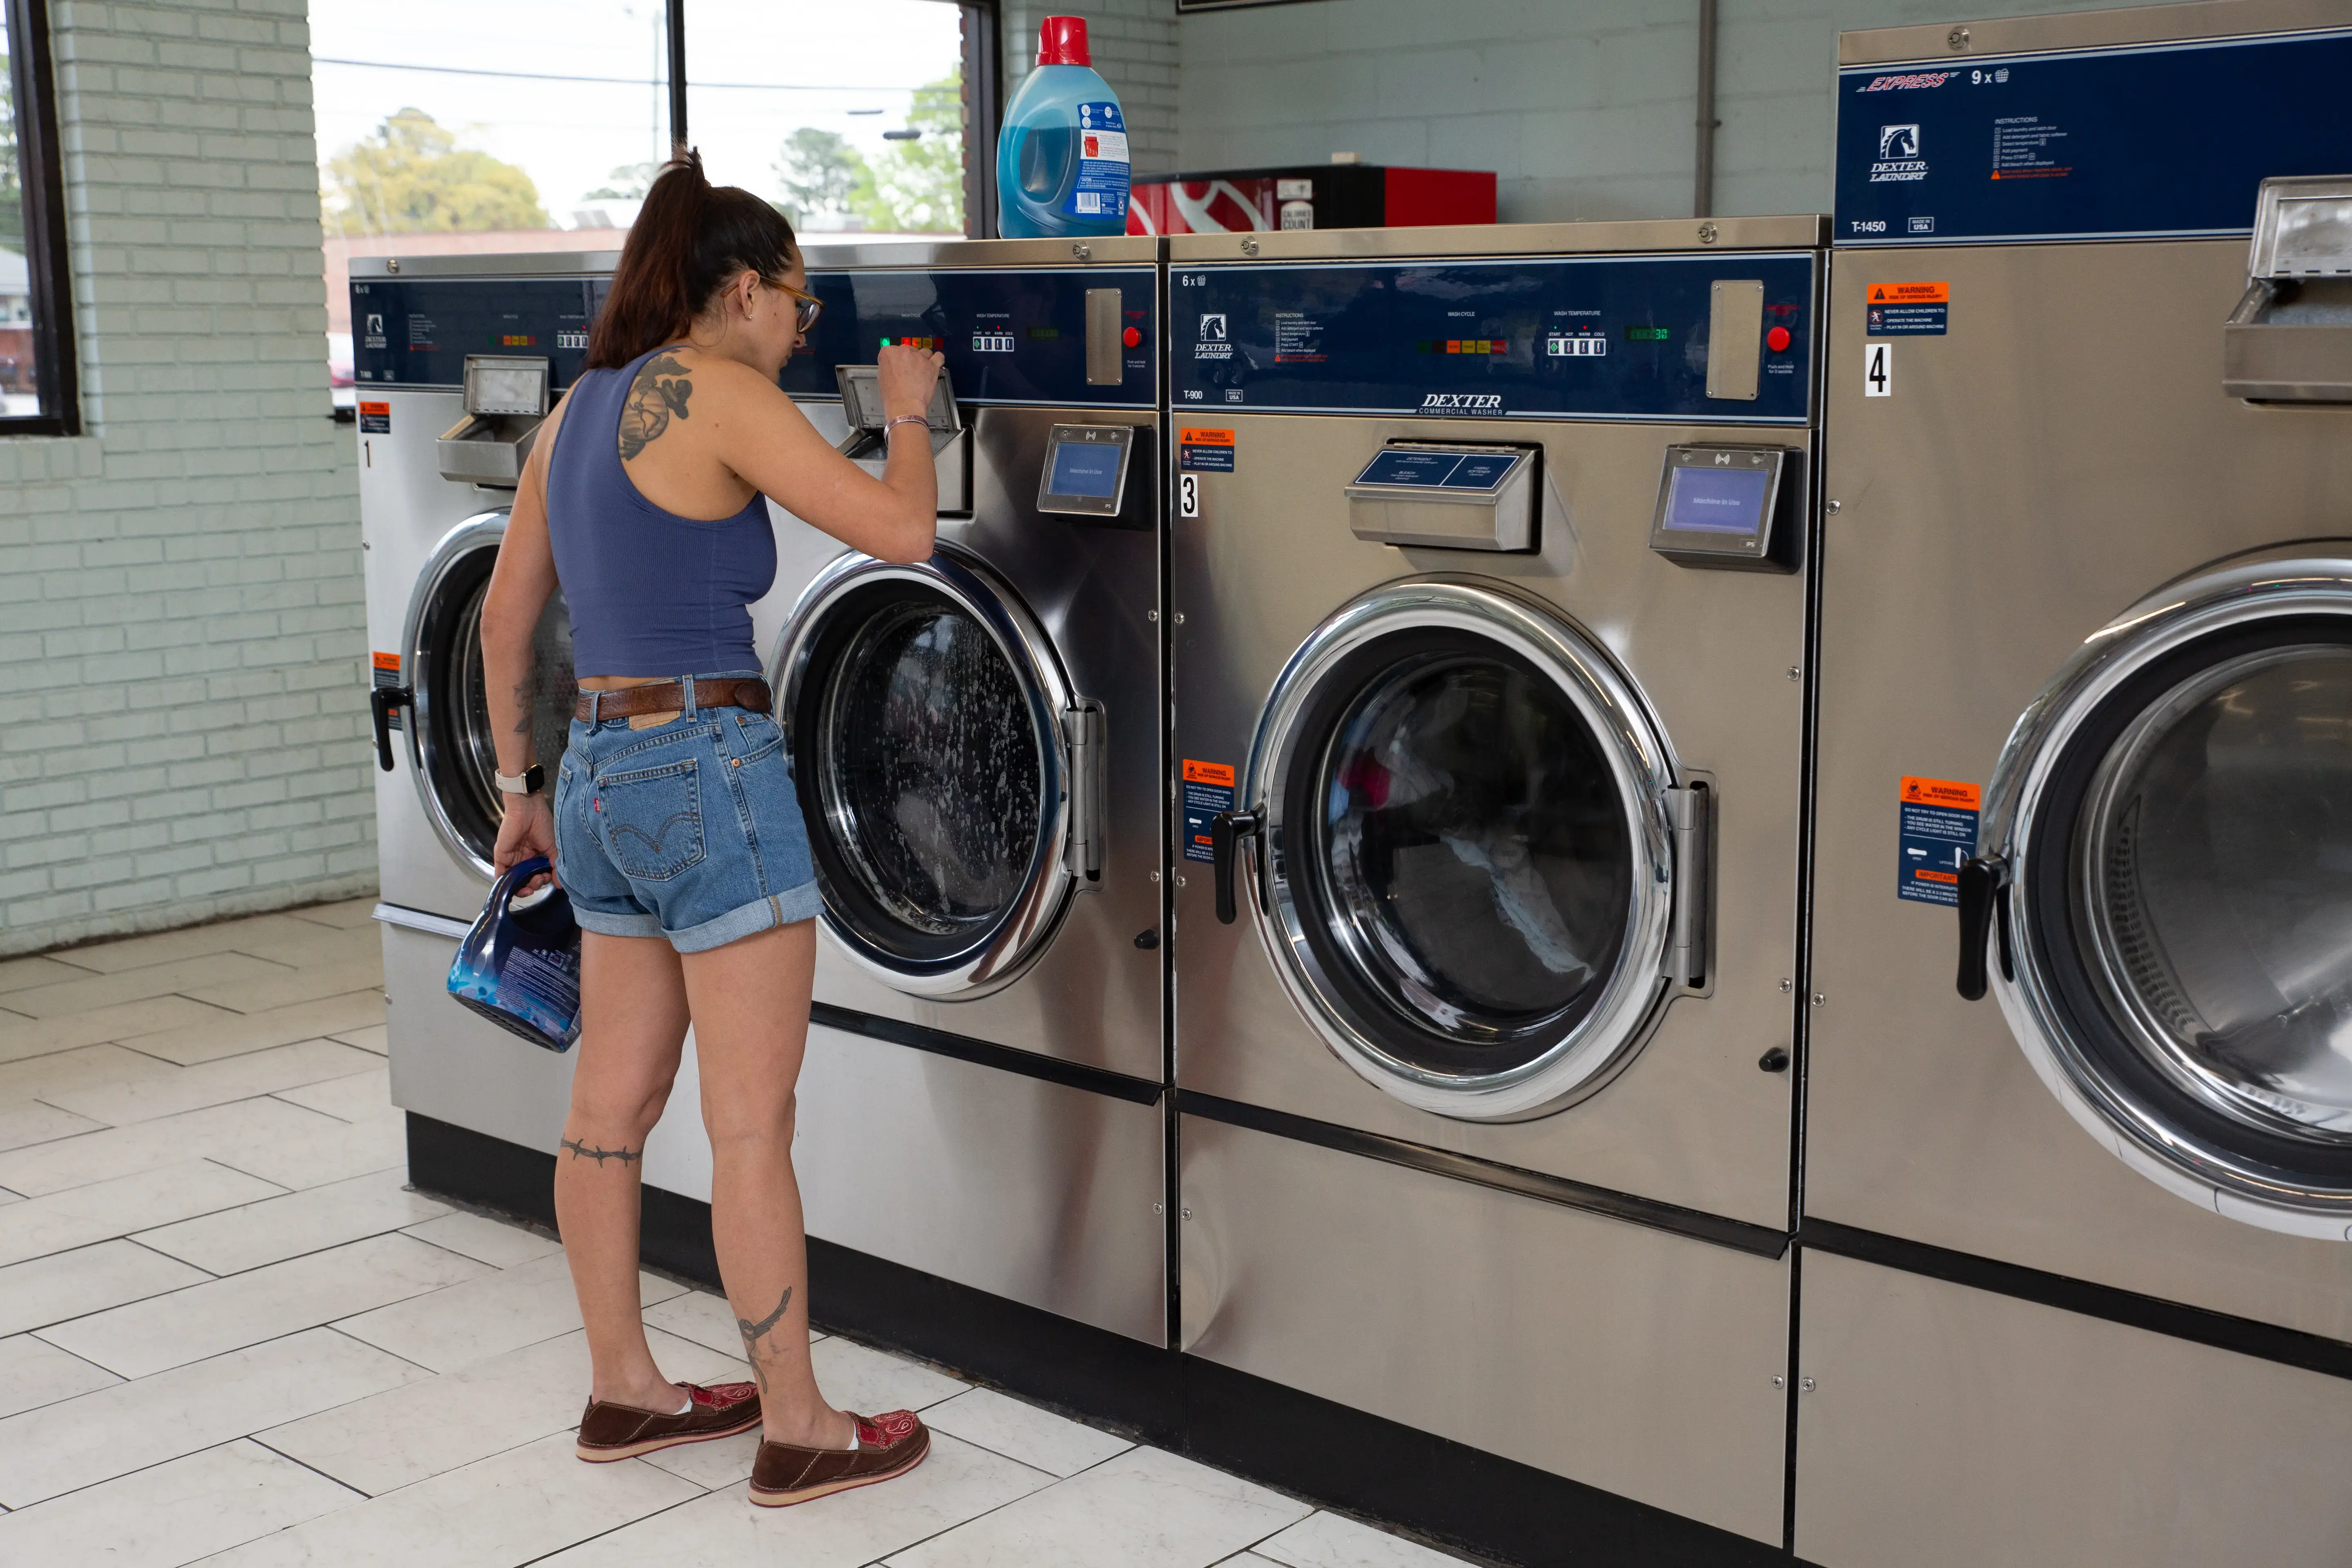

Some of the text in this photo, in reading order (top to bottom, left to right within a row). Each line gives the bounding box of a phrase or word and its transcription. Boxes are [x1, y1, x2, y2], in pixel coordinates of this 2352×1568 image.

[1866, 73, 1949, 91] EXPRESS
[1972, 70, 1981, 84] 9
[1871, 161, 1926, 172] DEXTER
[1869, 172, 1928, 182] LAUNDRY
[1283, 218, 1310, 230] COUNT
[1851, 221, 1886, 232] T-1450
[1183, 275, 1189, 286] 6
[1869, 347, 1886, 392] 4
[1184, 390, 1203, 399] T-900
[1421, 394, 1501, 408] DEXTER
[365, 439, 370, 468] 1
[1183, 477, 1195, 514] 3
[1203, 768, 1226, 776] WARNING
[1931, 786, 1967, 797] WARNING
[1920, 871, 1955, 881] IMPORTANT
